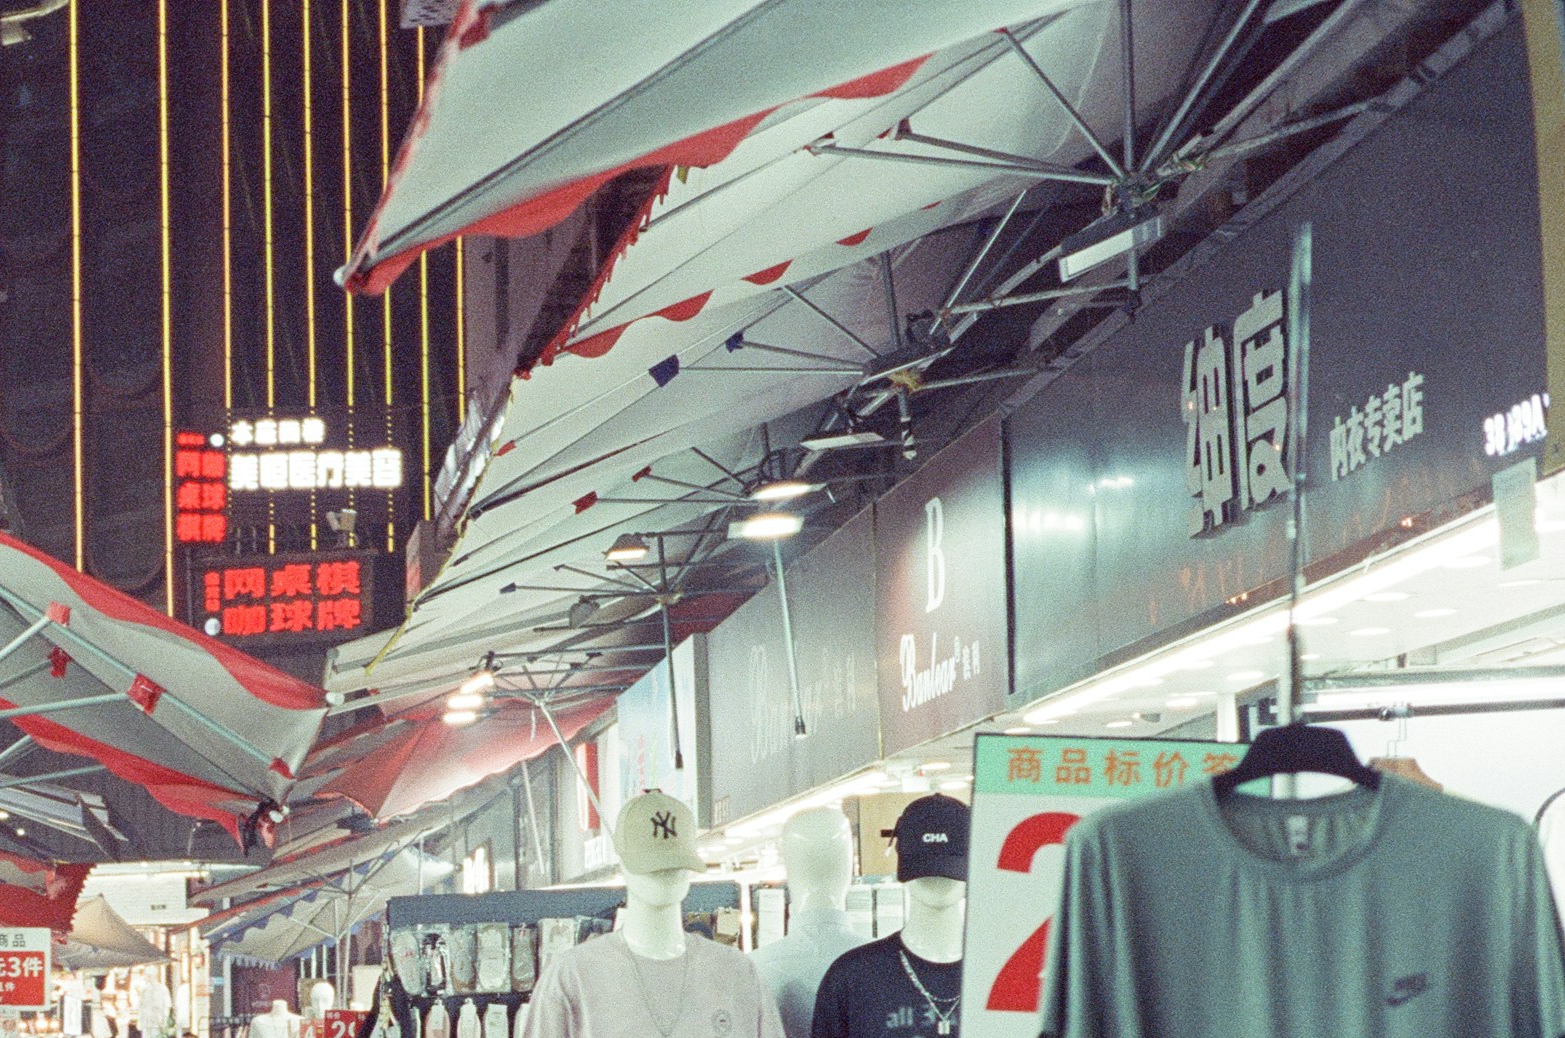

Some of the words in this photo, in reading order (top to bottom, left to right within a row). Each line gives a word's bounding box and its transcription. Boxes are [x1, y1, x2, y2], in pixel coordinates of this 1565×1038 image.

[1329, 371, 1425, 482] 内衣专卖店
[924, 496, 946, 614] B
[650, 811, 678, 839] NY
[922, 833, 948, 843] CHA
